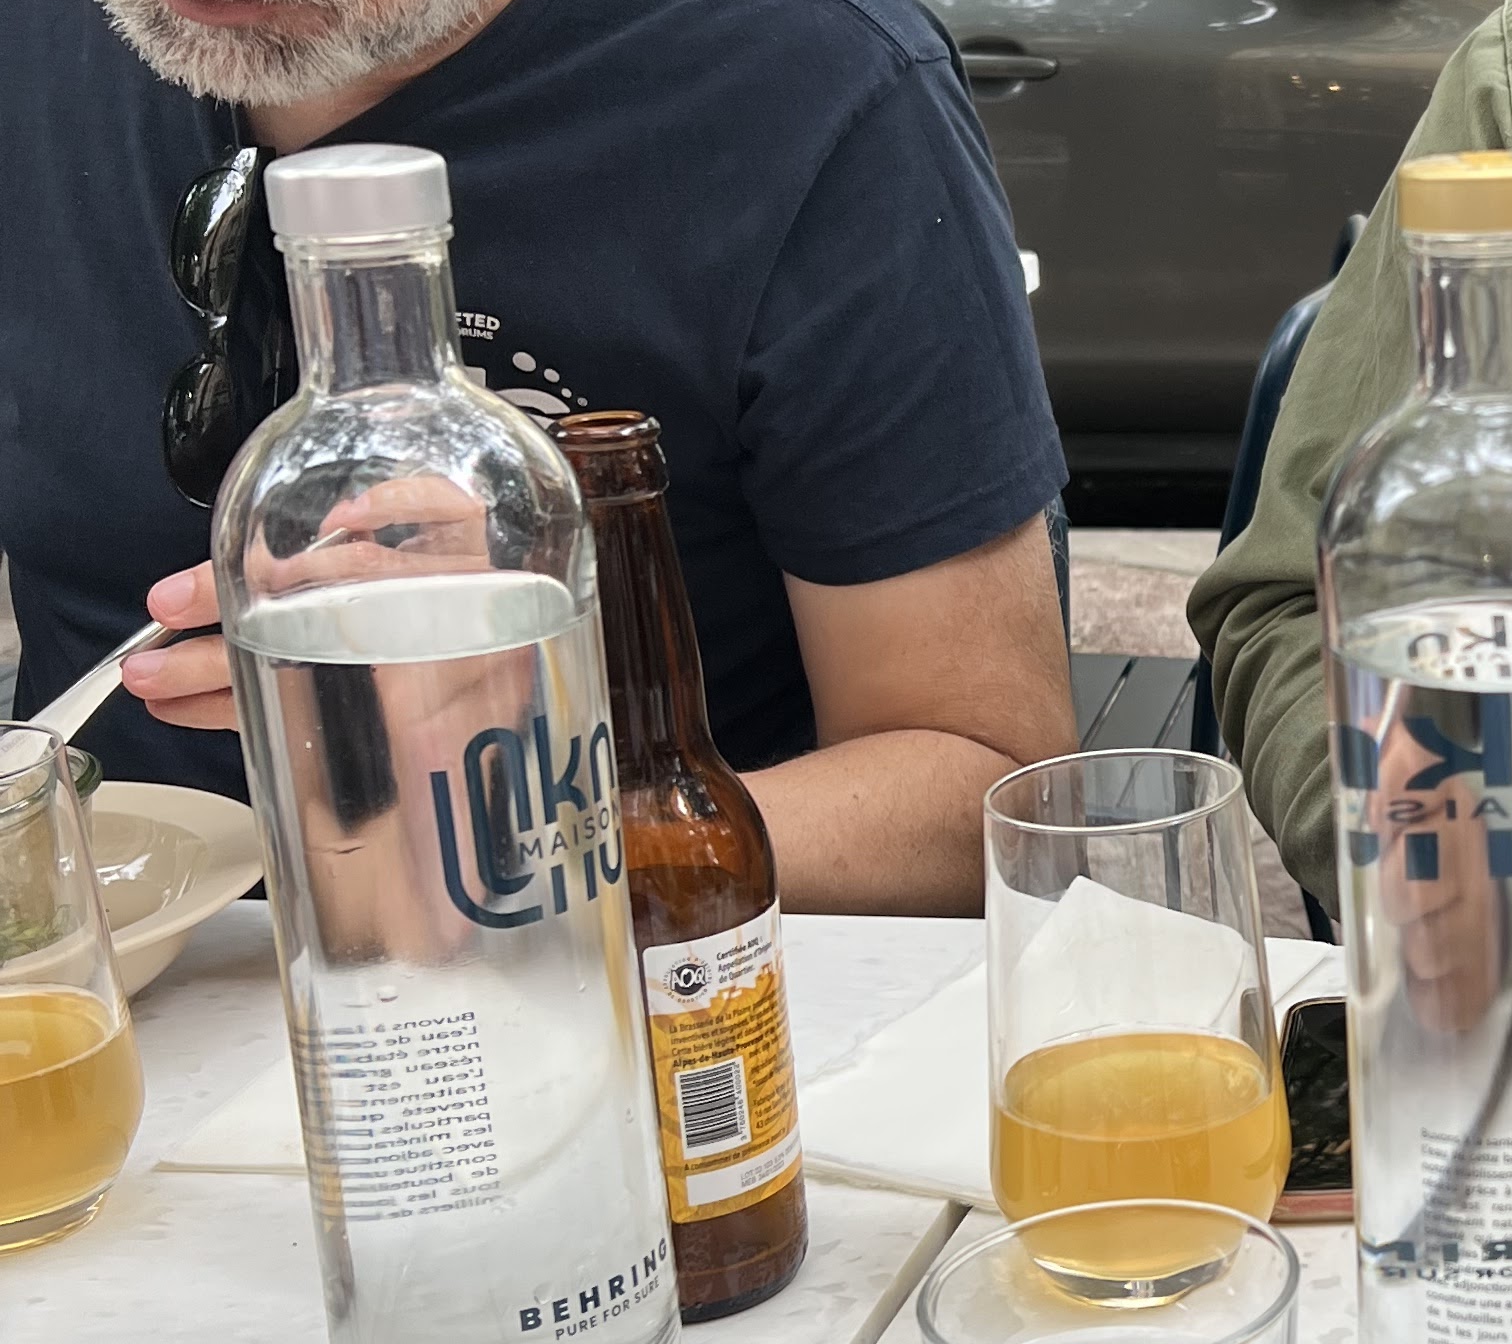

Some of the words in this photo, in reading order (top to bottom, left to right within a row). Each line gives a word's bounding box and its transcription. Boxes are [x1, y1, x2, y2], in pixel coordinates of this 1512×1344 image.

[519, 1238, 667, 1332] BEHRING
[555, 1316, 599, 1341] PURE
[603, 1299, 631, 1323] FOR
[634, 1275, 661, 1304] SURE
[1479, 1299, 1502, 1309] une
[1426, 1305, 1440, 1316] de
[1446, 1308, 1503, 1325] bouteilles
[1427, 1320, 1450, 1335] tous
[1455, 1325, 1472, 1338] les
[1477, 1329, 1508, 1341] jours
